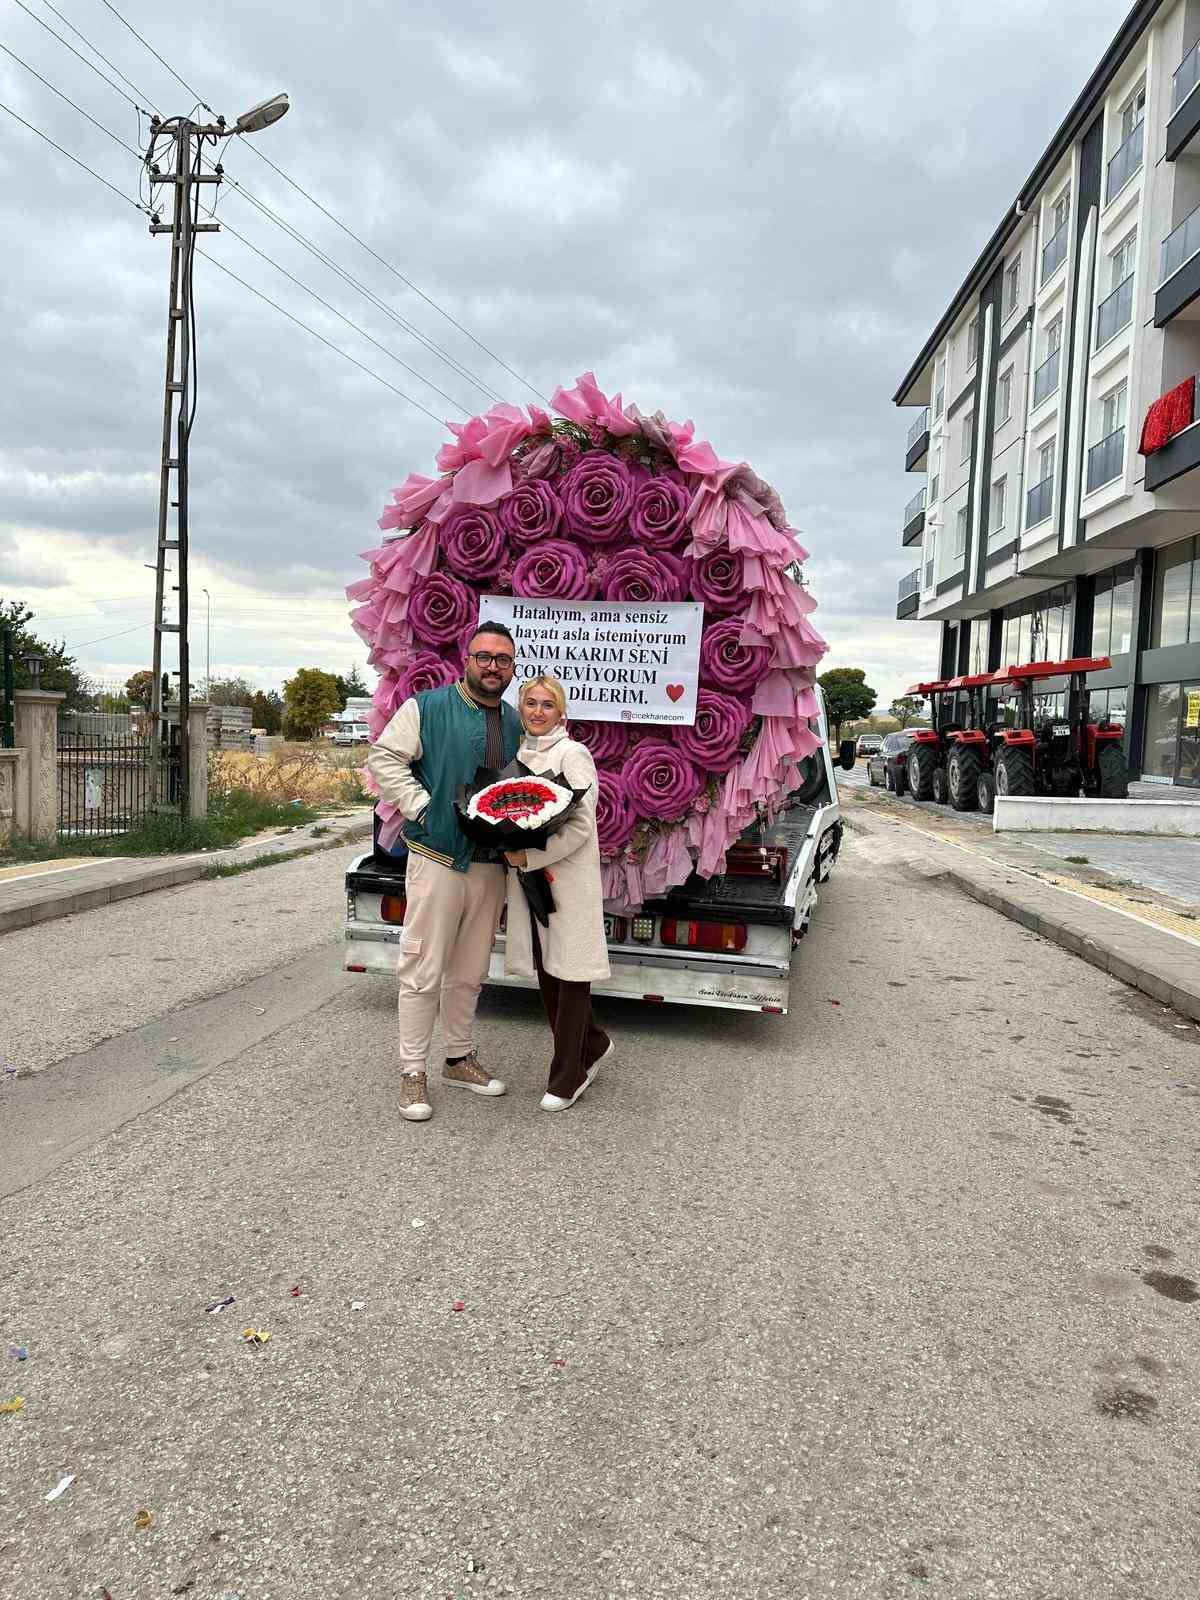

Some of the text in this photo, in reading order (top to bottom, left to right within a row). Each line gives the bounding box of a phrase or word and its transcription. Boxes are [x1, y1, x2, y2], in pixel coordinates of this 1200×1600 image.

[513, 605, 668, 624] Hatalıyım, ama sensiz
[515, 625, 686, 647] hayatı asla istemiyorum
[516, 644, 669, 664] ANIM KARIM SENİ
[514, 663, 657, 684] ÇOK SEVİYORUM
[569, 683, 648, 705] DİLERİM.
